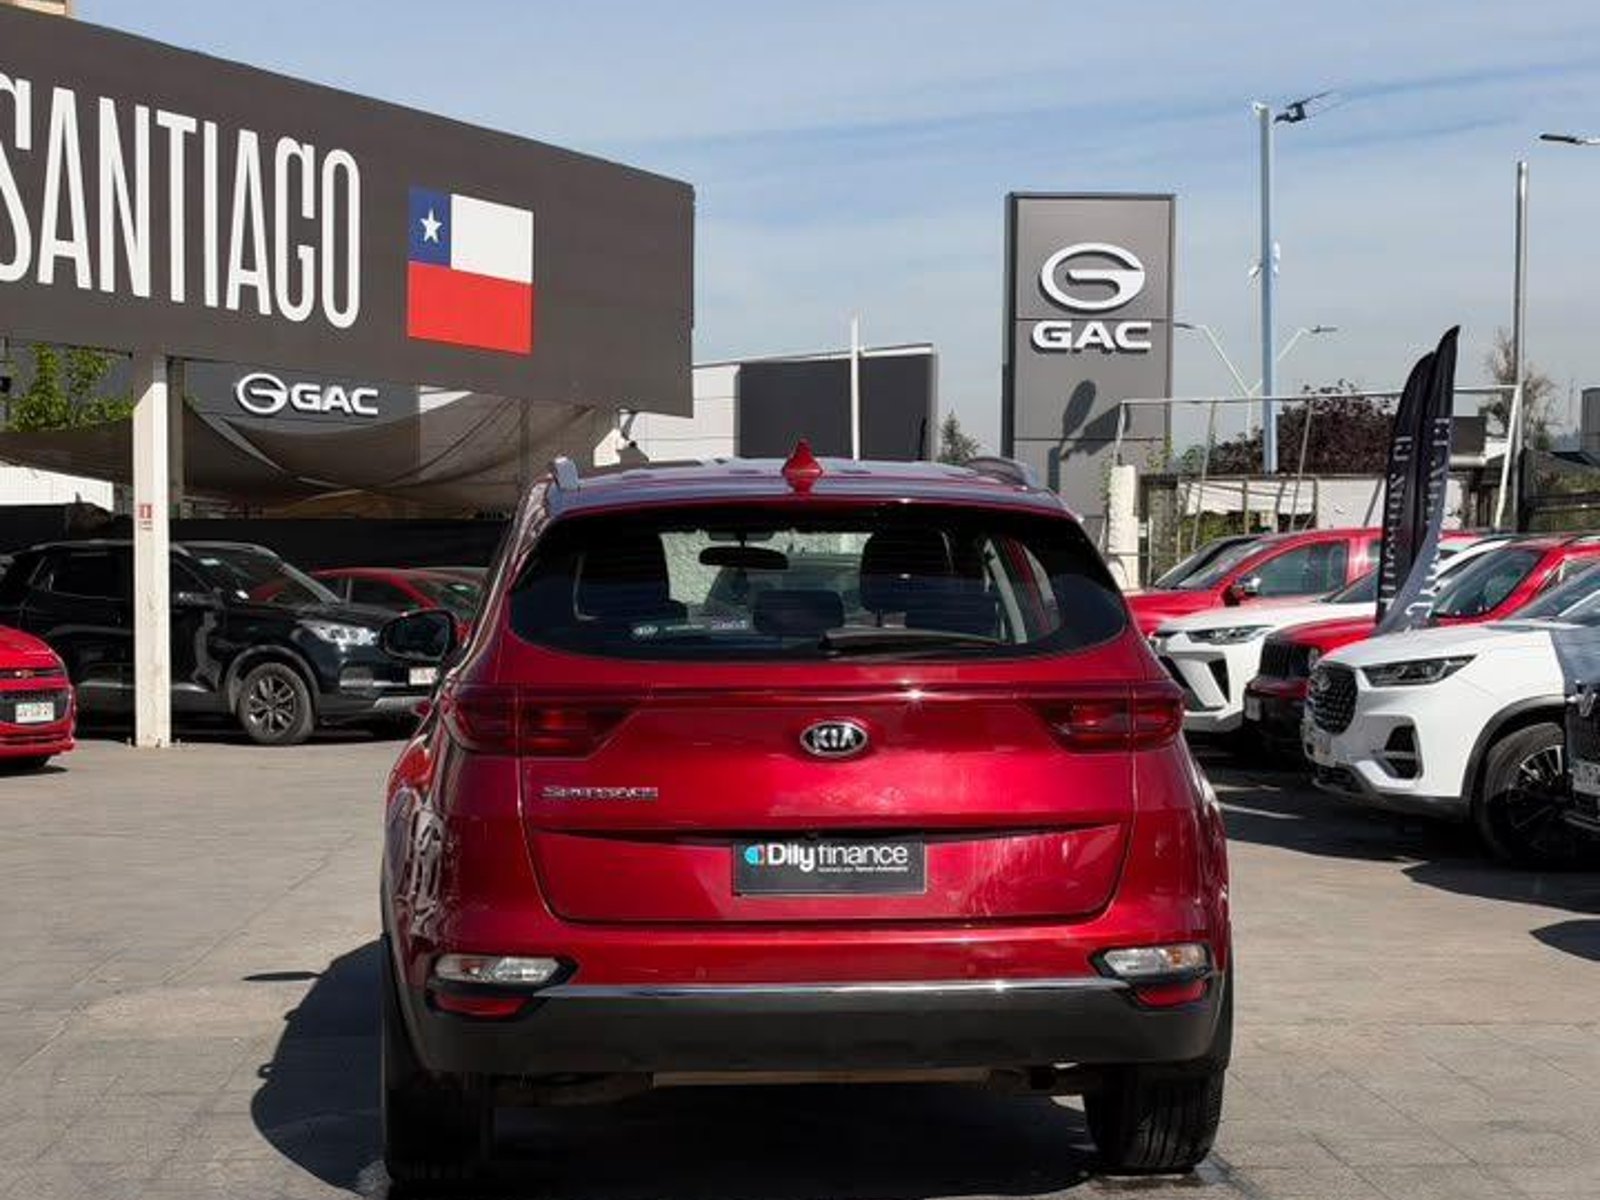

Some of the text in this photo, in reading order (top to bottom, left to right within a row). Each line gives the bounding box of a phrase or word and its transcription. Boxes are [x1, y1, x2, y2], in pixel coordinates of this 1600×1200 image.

[0, 72, 361, 329] SANTIAGO
[1032, 320, 1152, 350] GAC
[290, 381, 379, 416] GAC
[812, 726, 858, 749] KIA
